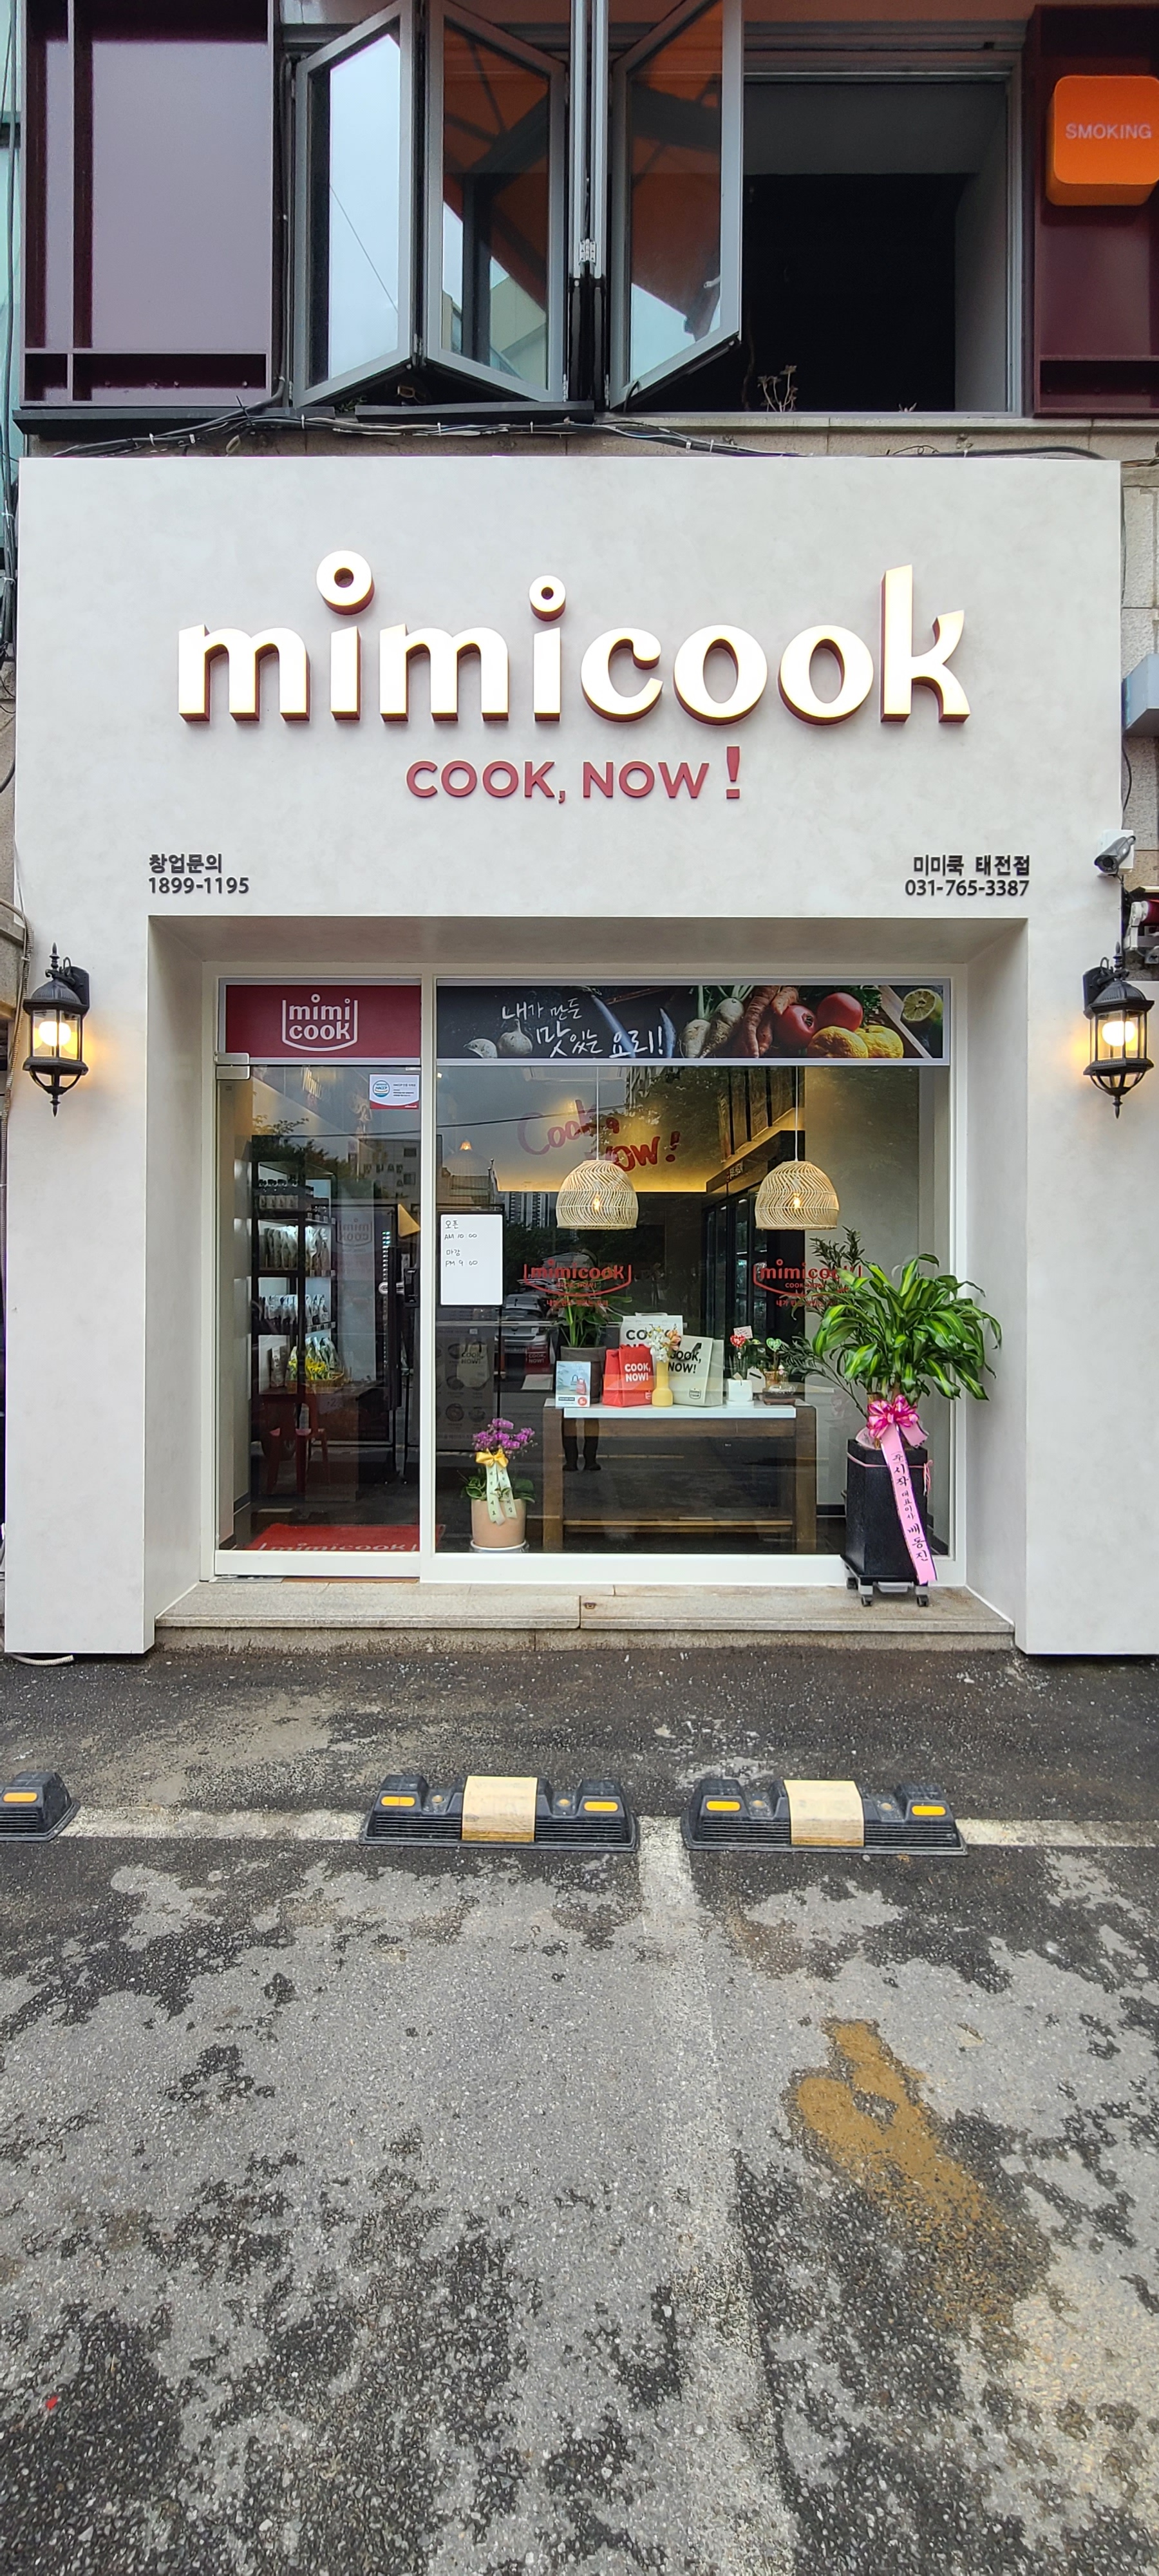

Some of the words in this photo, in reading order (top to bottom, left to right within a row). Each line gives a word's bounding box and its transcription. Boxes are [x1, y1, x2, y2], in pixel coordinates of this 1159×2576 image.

[1066, 123, 1153, 140] SMOKING
[178, 550, 971, 725] mimicook
[406, 759, 567, 804] COOK,
[149, 853, 223, 874] 창업문의
[913, 854, 965, 876] 미미쿡
[975, 854, 1030, 876] 태전점
[148, 876, 250, 895] 1899-1195
[905, 878, 1030, 896] 031-765-3387
[288, 993, 351, 1020] mimi
[502, 1001, 544, 1021] 내가
[551, 997, 583, 1021] 만든
[288, 1021, 351, 1040] cook
[536, 1019, 603, 1058] 맛있는
[608, 1025, 663, 1059] 요리!
[445, 1220, 459, 1229] 오픈
[531, 1258, 624, 1280] mimicook
[625, 1363, 651, 1372] COOK,
[625, 1372, 649, 1383] NOW!
[668, 1361, 697, 1374] NOW!
